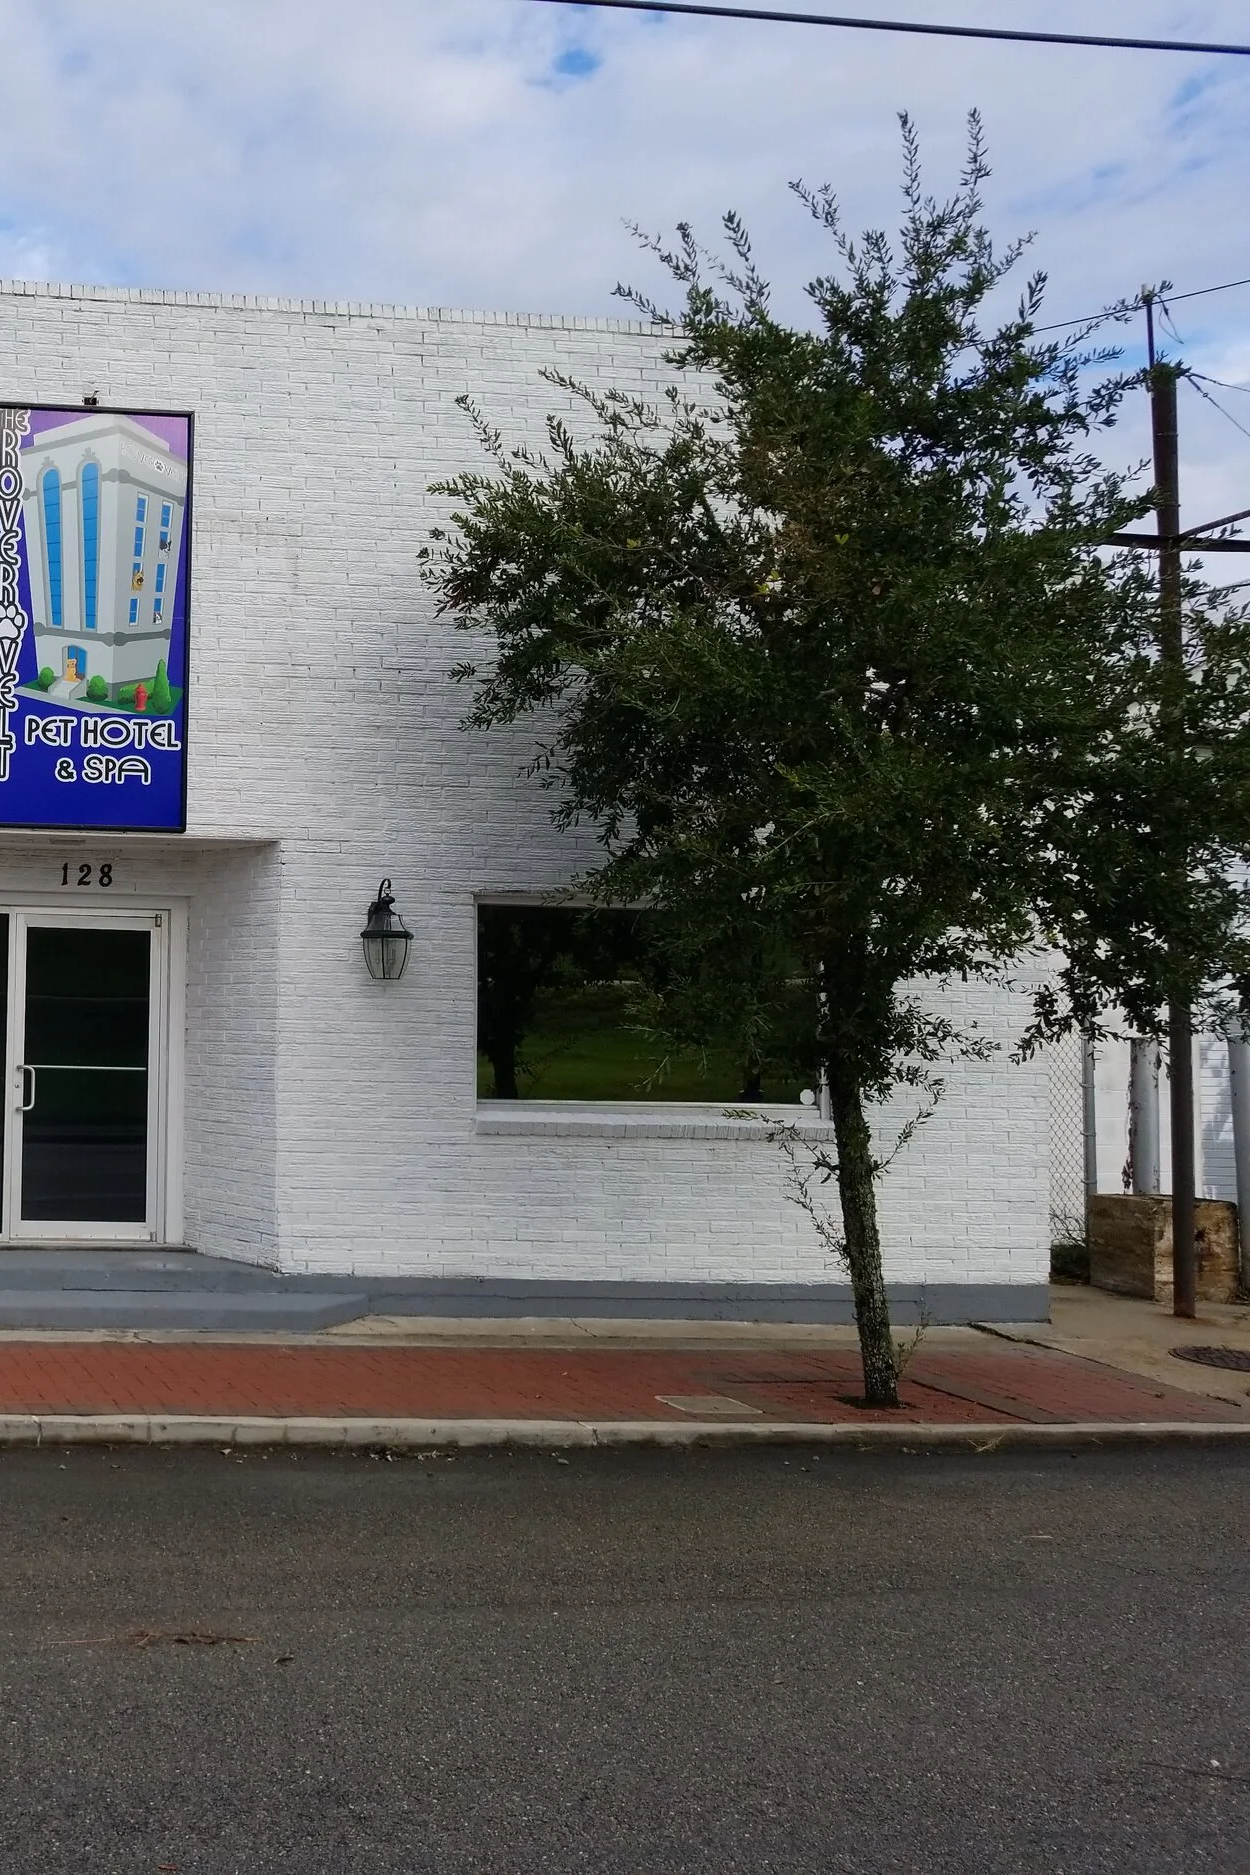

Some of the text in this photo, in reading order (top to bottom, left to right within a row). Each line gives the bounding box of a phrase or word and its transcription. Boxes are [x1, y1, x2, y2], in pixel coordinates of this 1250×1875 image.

[26, 717, 180, 749] PET HOTEL
[56, 755, 150, 784] & SPA
[61, 862, 113, 888] 128
